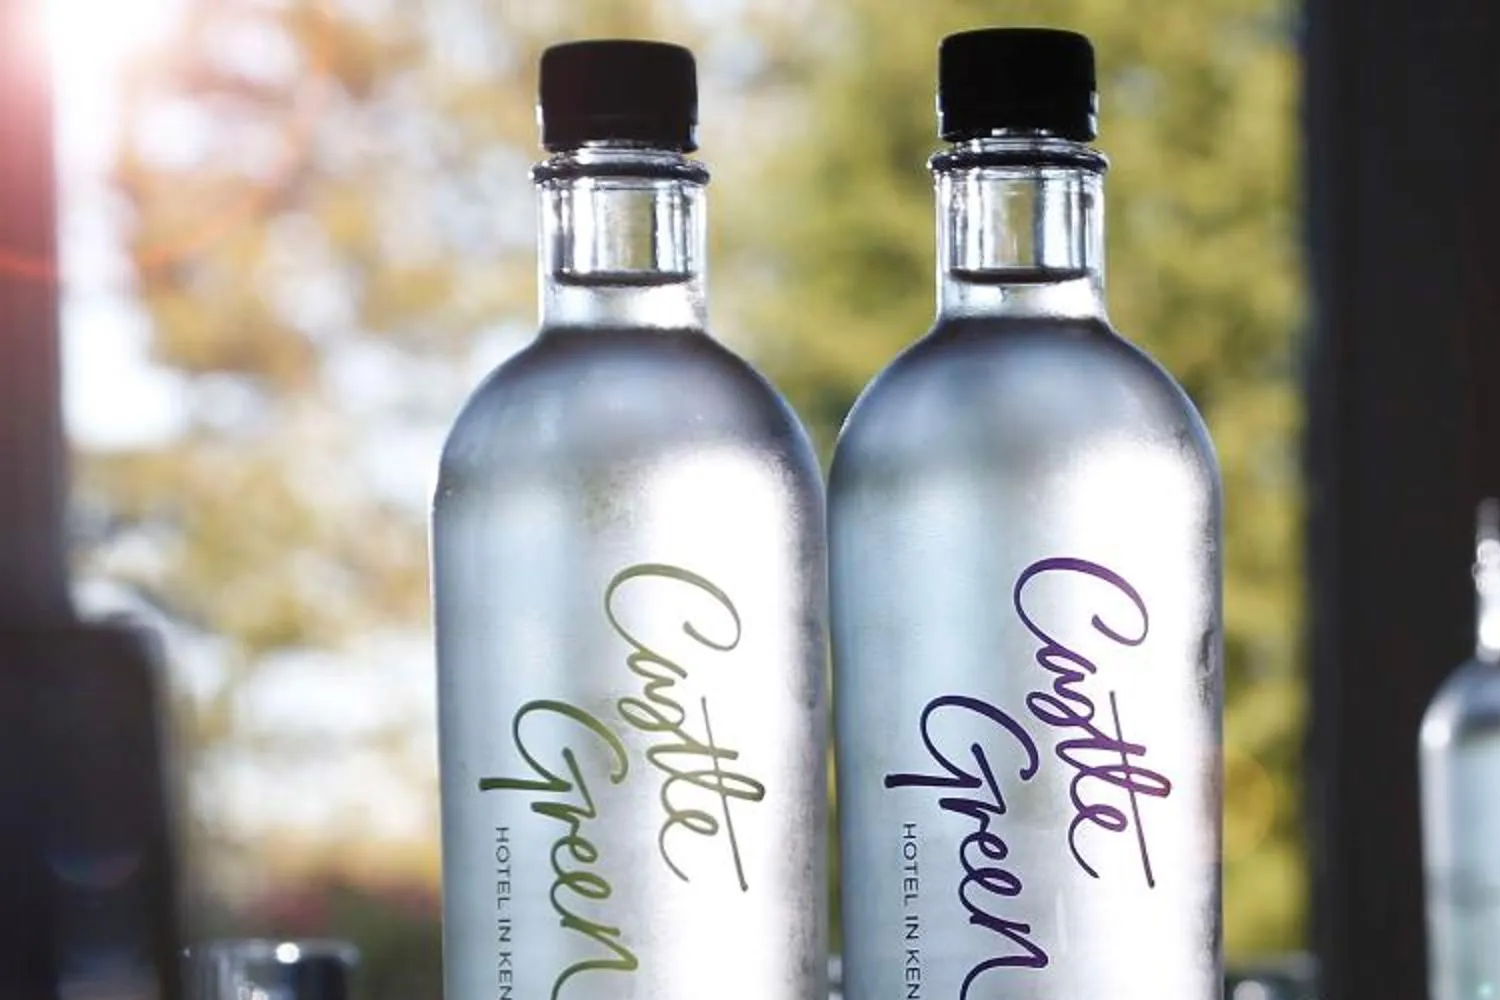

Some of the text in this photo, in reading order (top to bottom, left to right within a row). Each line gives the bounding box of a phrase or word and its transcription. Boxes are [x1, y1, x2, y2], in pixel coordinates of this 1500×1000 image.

[604, 562, 766, 892] Castle
[1013, 557, 1172, 888] Castle
[496, 826, 511, 909] HOTEL
[902, 823, 918, 906] HOTEL
[498, 918, 511, 943] IN
[905, 915, 919, 940] IN
